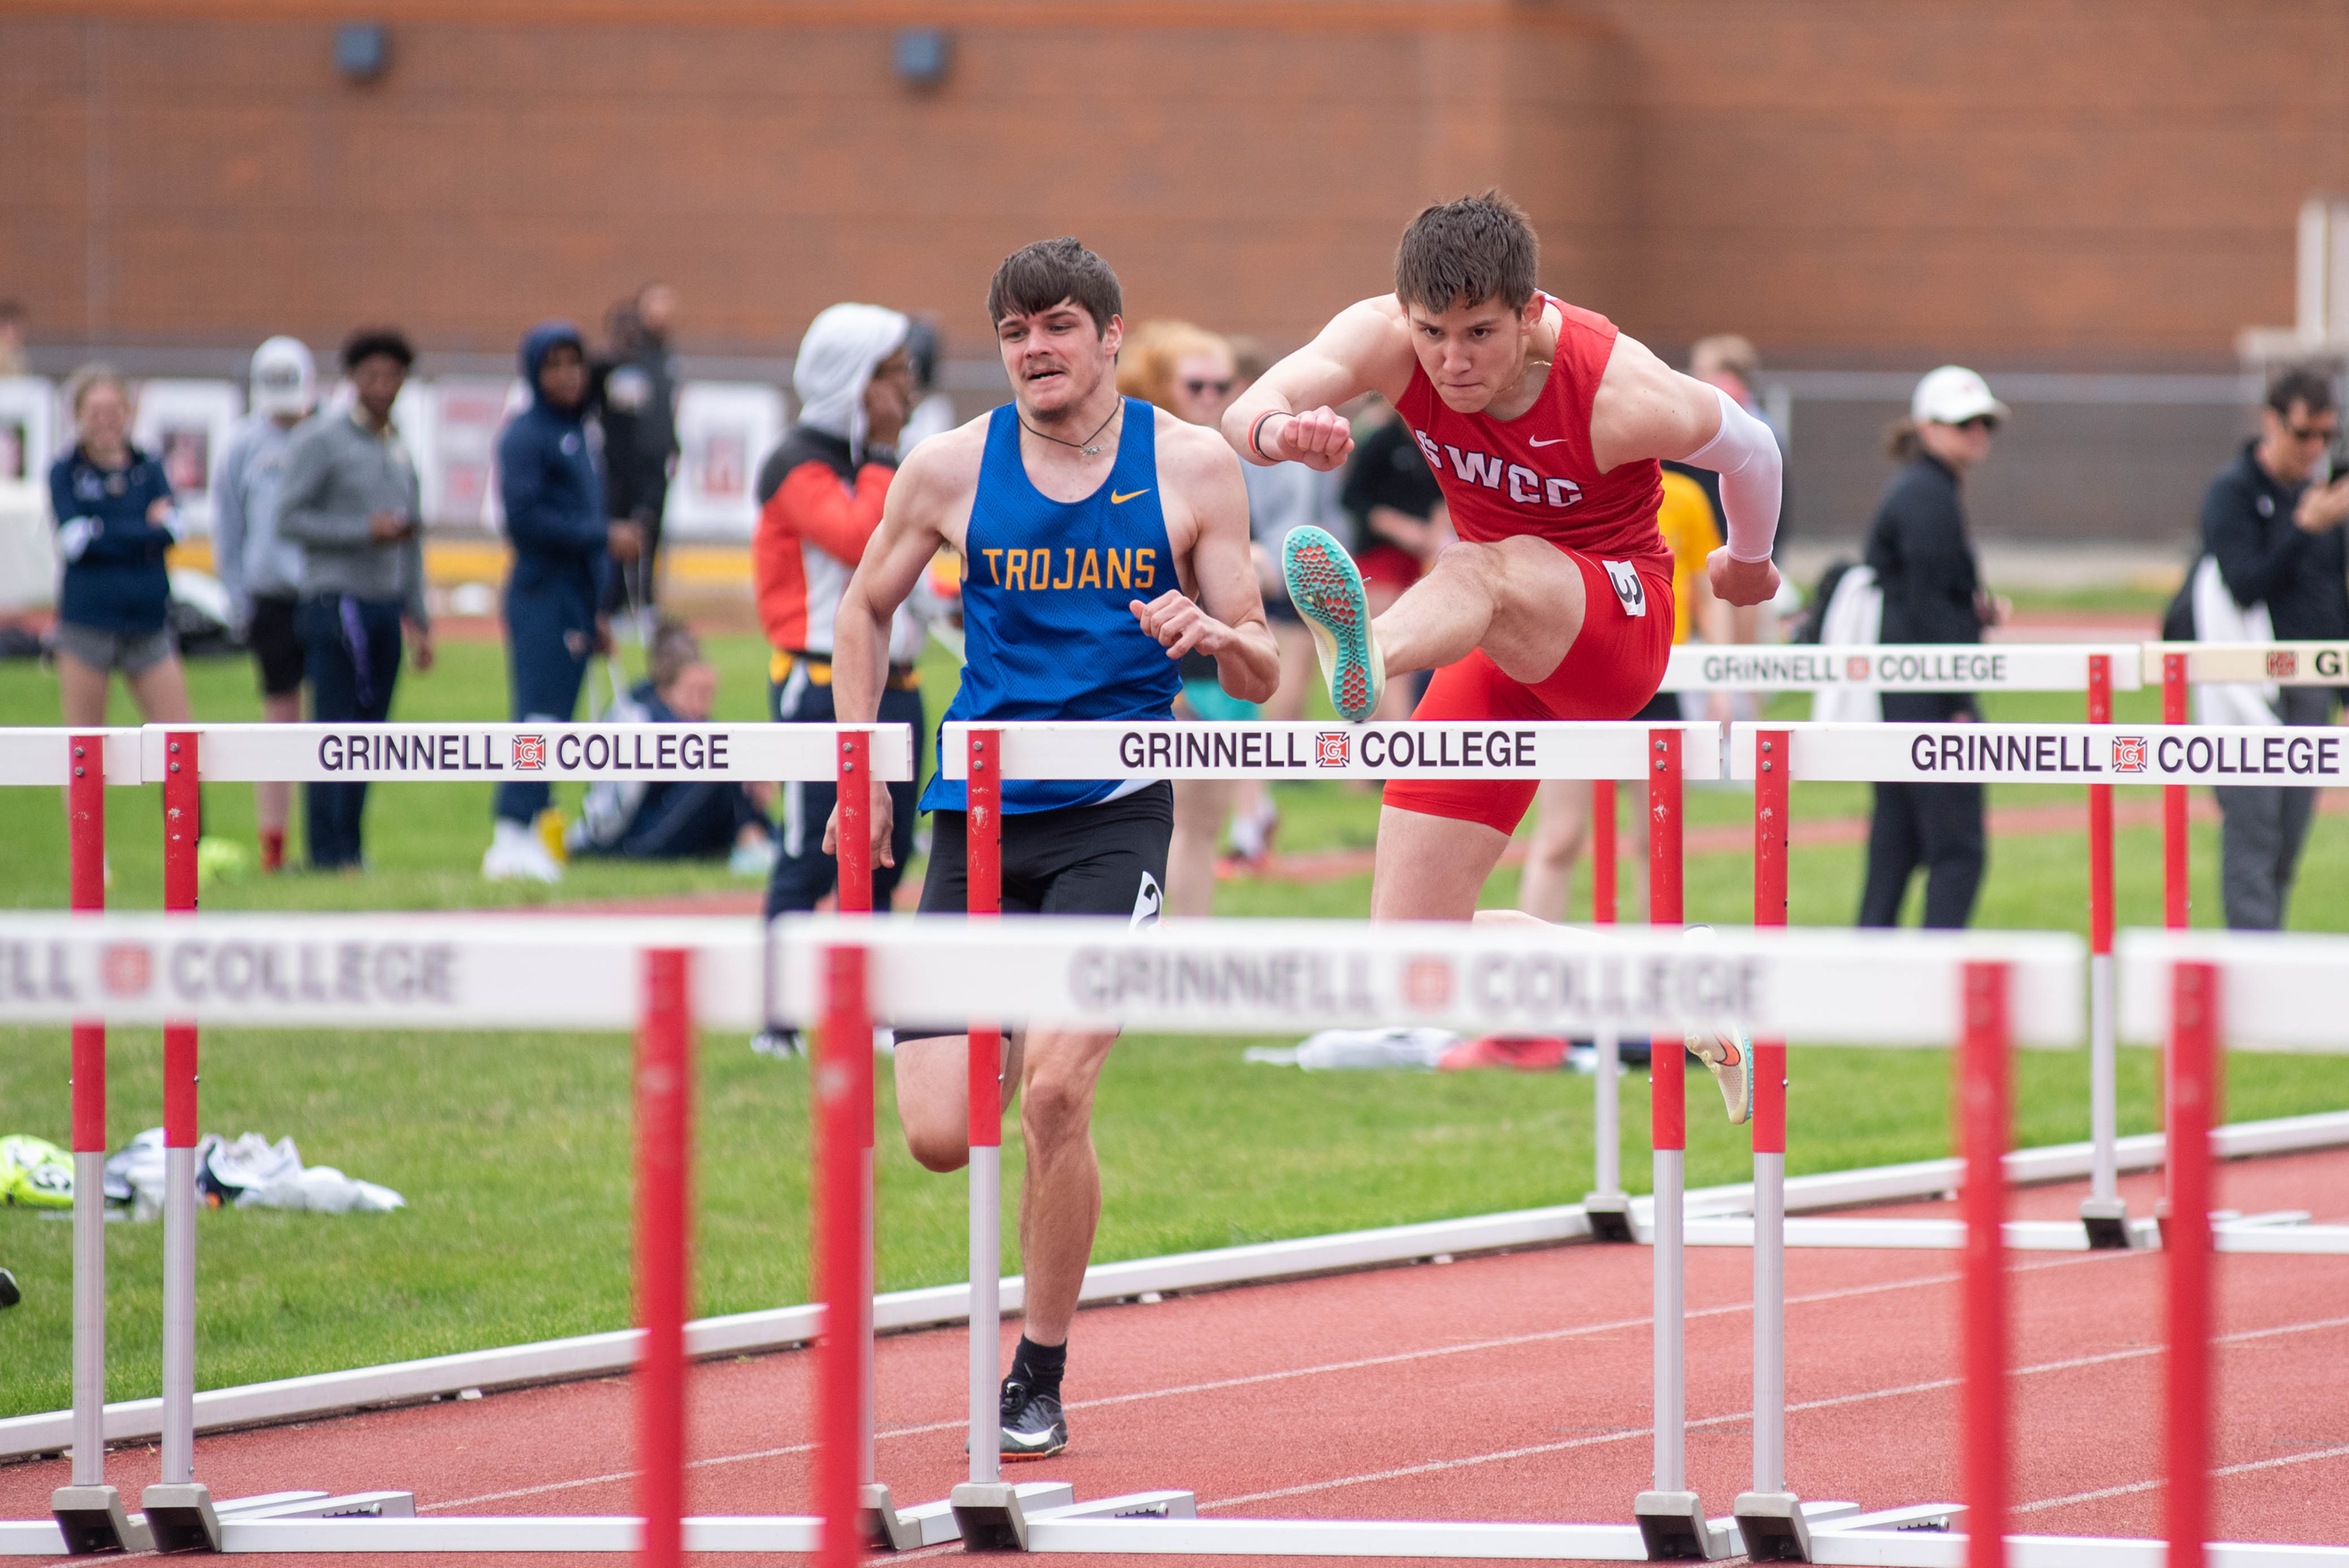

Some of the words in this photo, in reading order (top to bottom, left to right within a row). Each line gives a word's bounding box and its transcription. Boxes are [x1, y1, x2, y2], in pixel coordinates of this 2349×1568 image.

[1414, 428, 1584, 508] SWCC
[981, 547, 1157, 591] TROJANS
[1703, 655, 1839, 682] GRINNELL
[1878, 654, 2007, 681] COLLEGE
[2315, 650, 2349, 677] G
[318, 734, 504, 771] GRINNELL
[556, 734, 729, 770] COLLEGE
[1119, 731, 1306, 768] GRINNELL
[1360, 731, 1536, 767] COLLEGE
[1911, 734, 2103, 772] GRINNELL
[2158, 736, 2340, 774] COLLEGE
[169, 940, 459, 1001] COLLEGE
[1067, 946, 1378, 1012] GRINNELL
[1470, 950, 1768, 1016] COLLEGE
